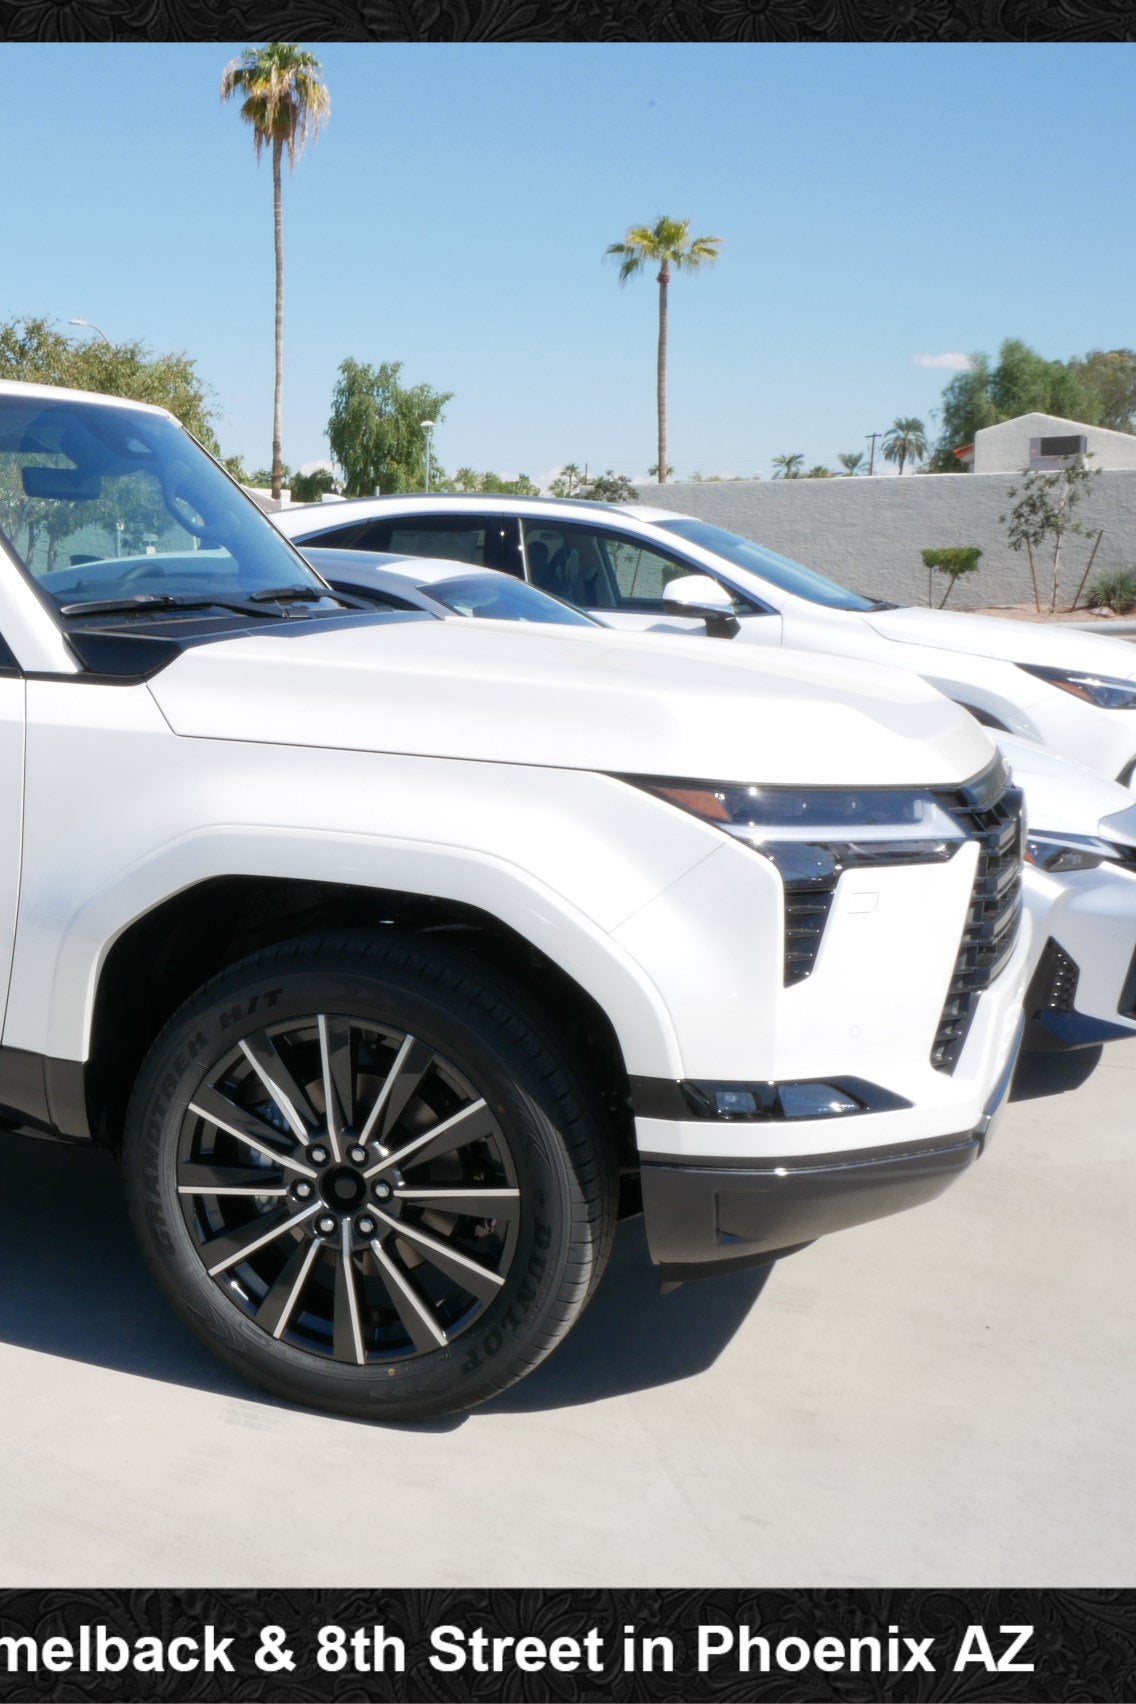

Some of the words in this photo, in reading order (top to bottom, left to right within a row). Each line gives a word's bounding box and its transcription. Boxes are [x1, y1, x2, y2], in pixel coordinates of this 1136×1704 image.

[143, 1032, 208, 1256] GRANDTREK
[219, 988, 283, 1031] H/T
[460, 1218, 552, 1375] DUNLOP
